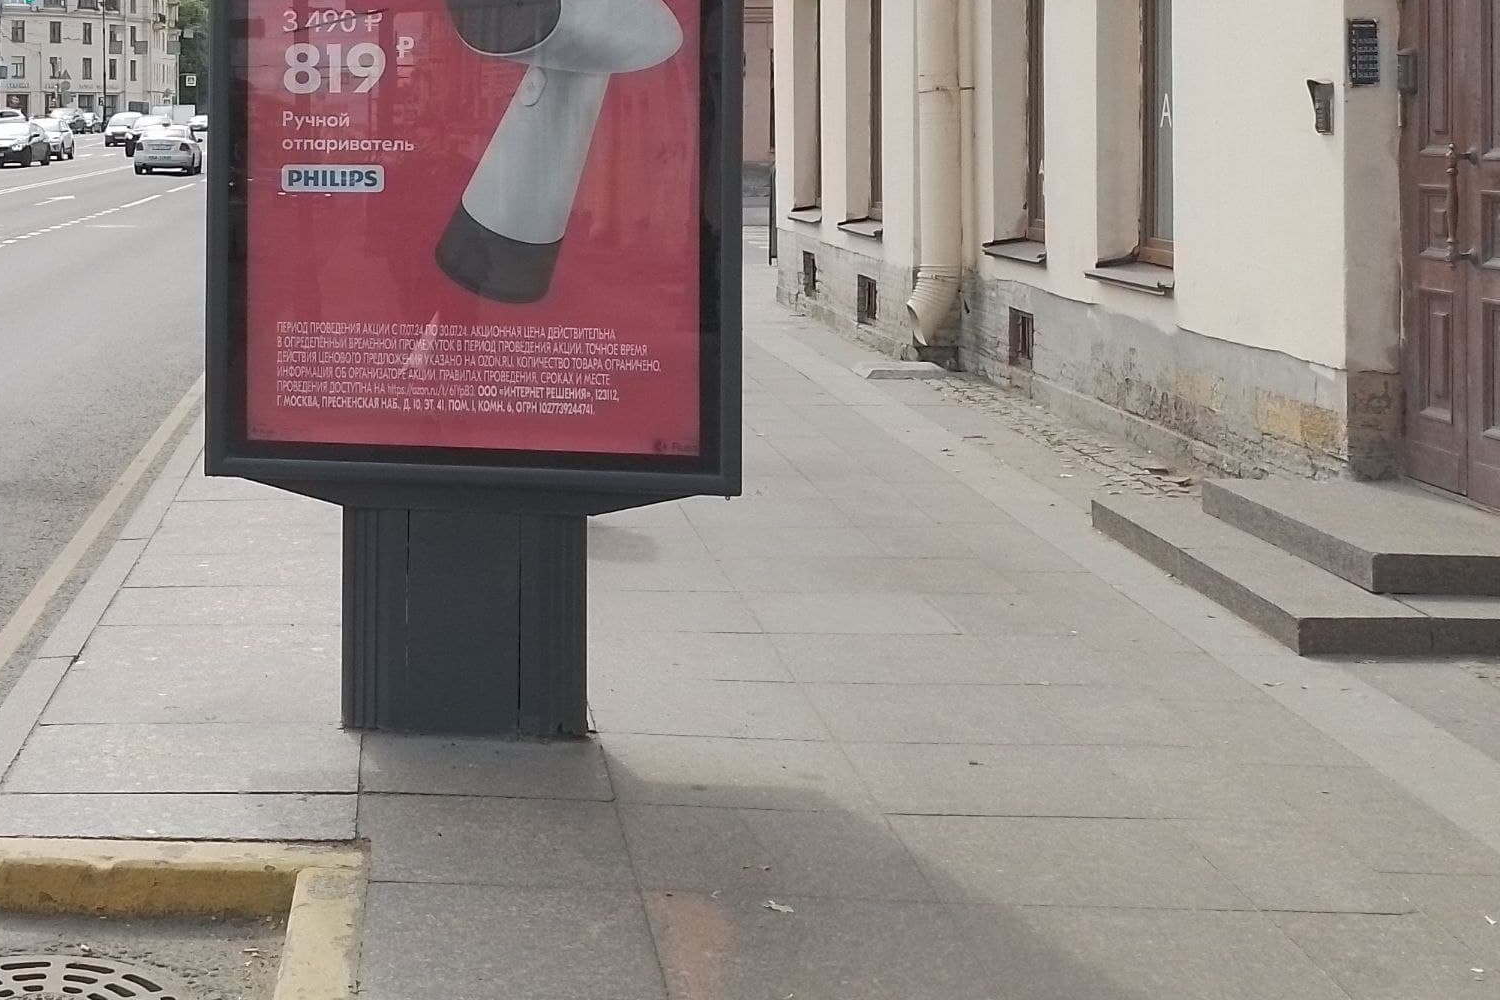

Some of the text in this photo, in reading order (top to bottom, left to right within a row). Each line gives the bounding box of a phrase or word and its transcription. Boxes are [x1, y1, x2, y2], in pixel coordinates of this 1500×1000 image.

[283, 43, 386, 94] 819
[282, 110, 350, 131] Ручной
[282, 137, 415, 154] отпариватель
[288, 169, 378, 187] PHILIPS
[277, 322, 308, 334] ПЕРИОД
[310, 322, 360, 335] ПРОВЕДЕНИЯ
[362, 323, 390, 335] АКЦИИ
[392, 323, 398, 335] С
[425, 324, 438, 336] ПО
[471, 325, 523, 339] АКЦИОННАЯ
[524, 326, 546, 340] ЦЕНА
[547, 326, 616, 340] ДЕЙСТВИТЕЛЬНА
[277, 336, 282, 348] В
[349, 337, 397, 350] ВРЕМЕННОЙ
[399, 339, 455, 351] ПРОМЕЖУТОК
[457, 340, 462, 351] В
[464, 340, 496, 352] ПЕРИОД
[498, 340, 551, 354] ПРОВЕДЕНИЯ
[585, 343, 618, 355] ТОЧНОЕ
[620, 343, 647, 356] ВРЕМЯ
[277, 350, 317, 364] ДЕЙСТВИЯ
[318, 351, 361, 364] ЦЕНОВОГО
[363, 352, 422, 366] ПРЕДЛОЖЕНИЯ
[423, 353, 462, 366] УКАЗАНО
[464, 354, 476, 366] НА
[516, 356, 570, 369] КОЛИЧЕСТВО
[571, 357, 603, 370] ТОВАРА
[604, 359, 661, 372] ОГРАНИЧЕНО.
[277, 366, 333, 379] ИНФОРМАЦИЯ
[335, 366, 346, 378] ОБ
[348, 367, 406, 380] ОРГАНИЗАТОРЕ
[439, 369, 482, 382] ПРАВИЛАХ
[540, 372, 573, 385] СРОКАХ
[576, 373, 581, 385] И
[584, 373, 611, 386] МЕСТЕ
[277, 380, 327, 393] ПРОВЕДЕНИЯ
[329, 381, 372, 394] ДОСТУПНА
[374, 382, 386, 394] НА
[478, 385, 497, 397] ООО
[499, 386, 545, 399] «ИНТЕРНЕТ
[321, 396, 380, 409] ПРЕСНЕНСКАЯ
[515, 401, 537, 414] ОГРН
